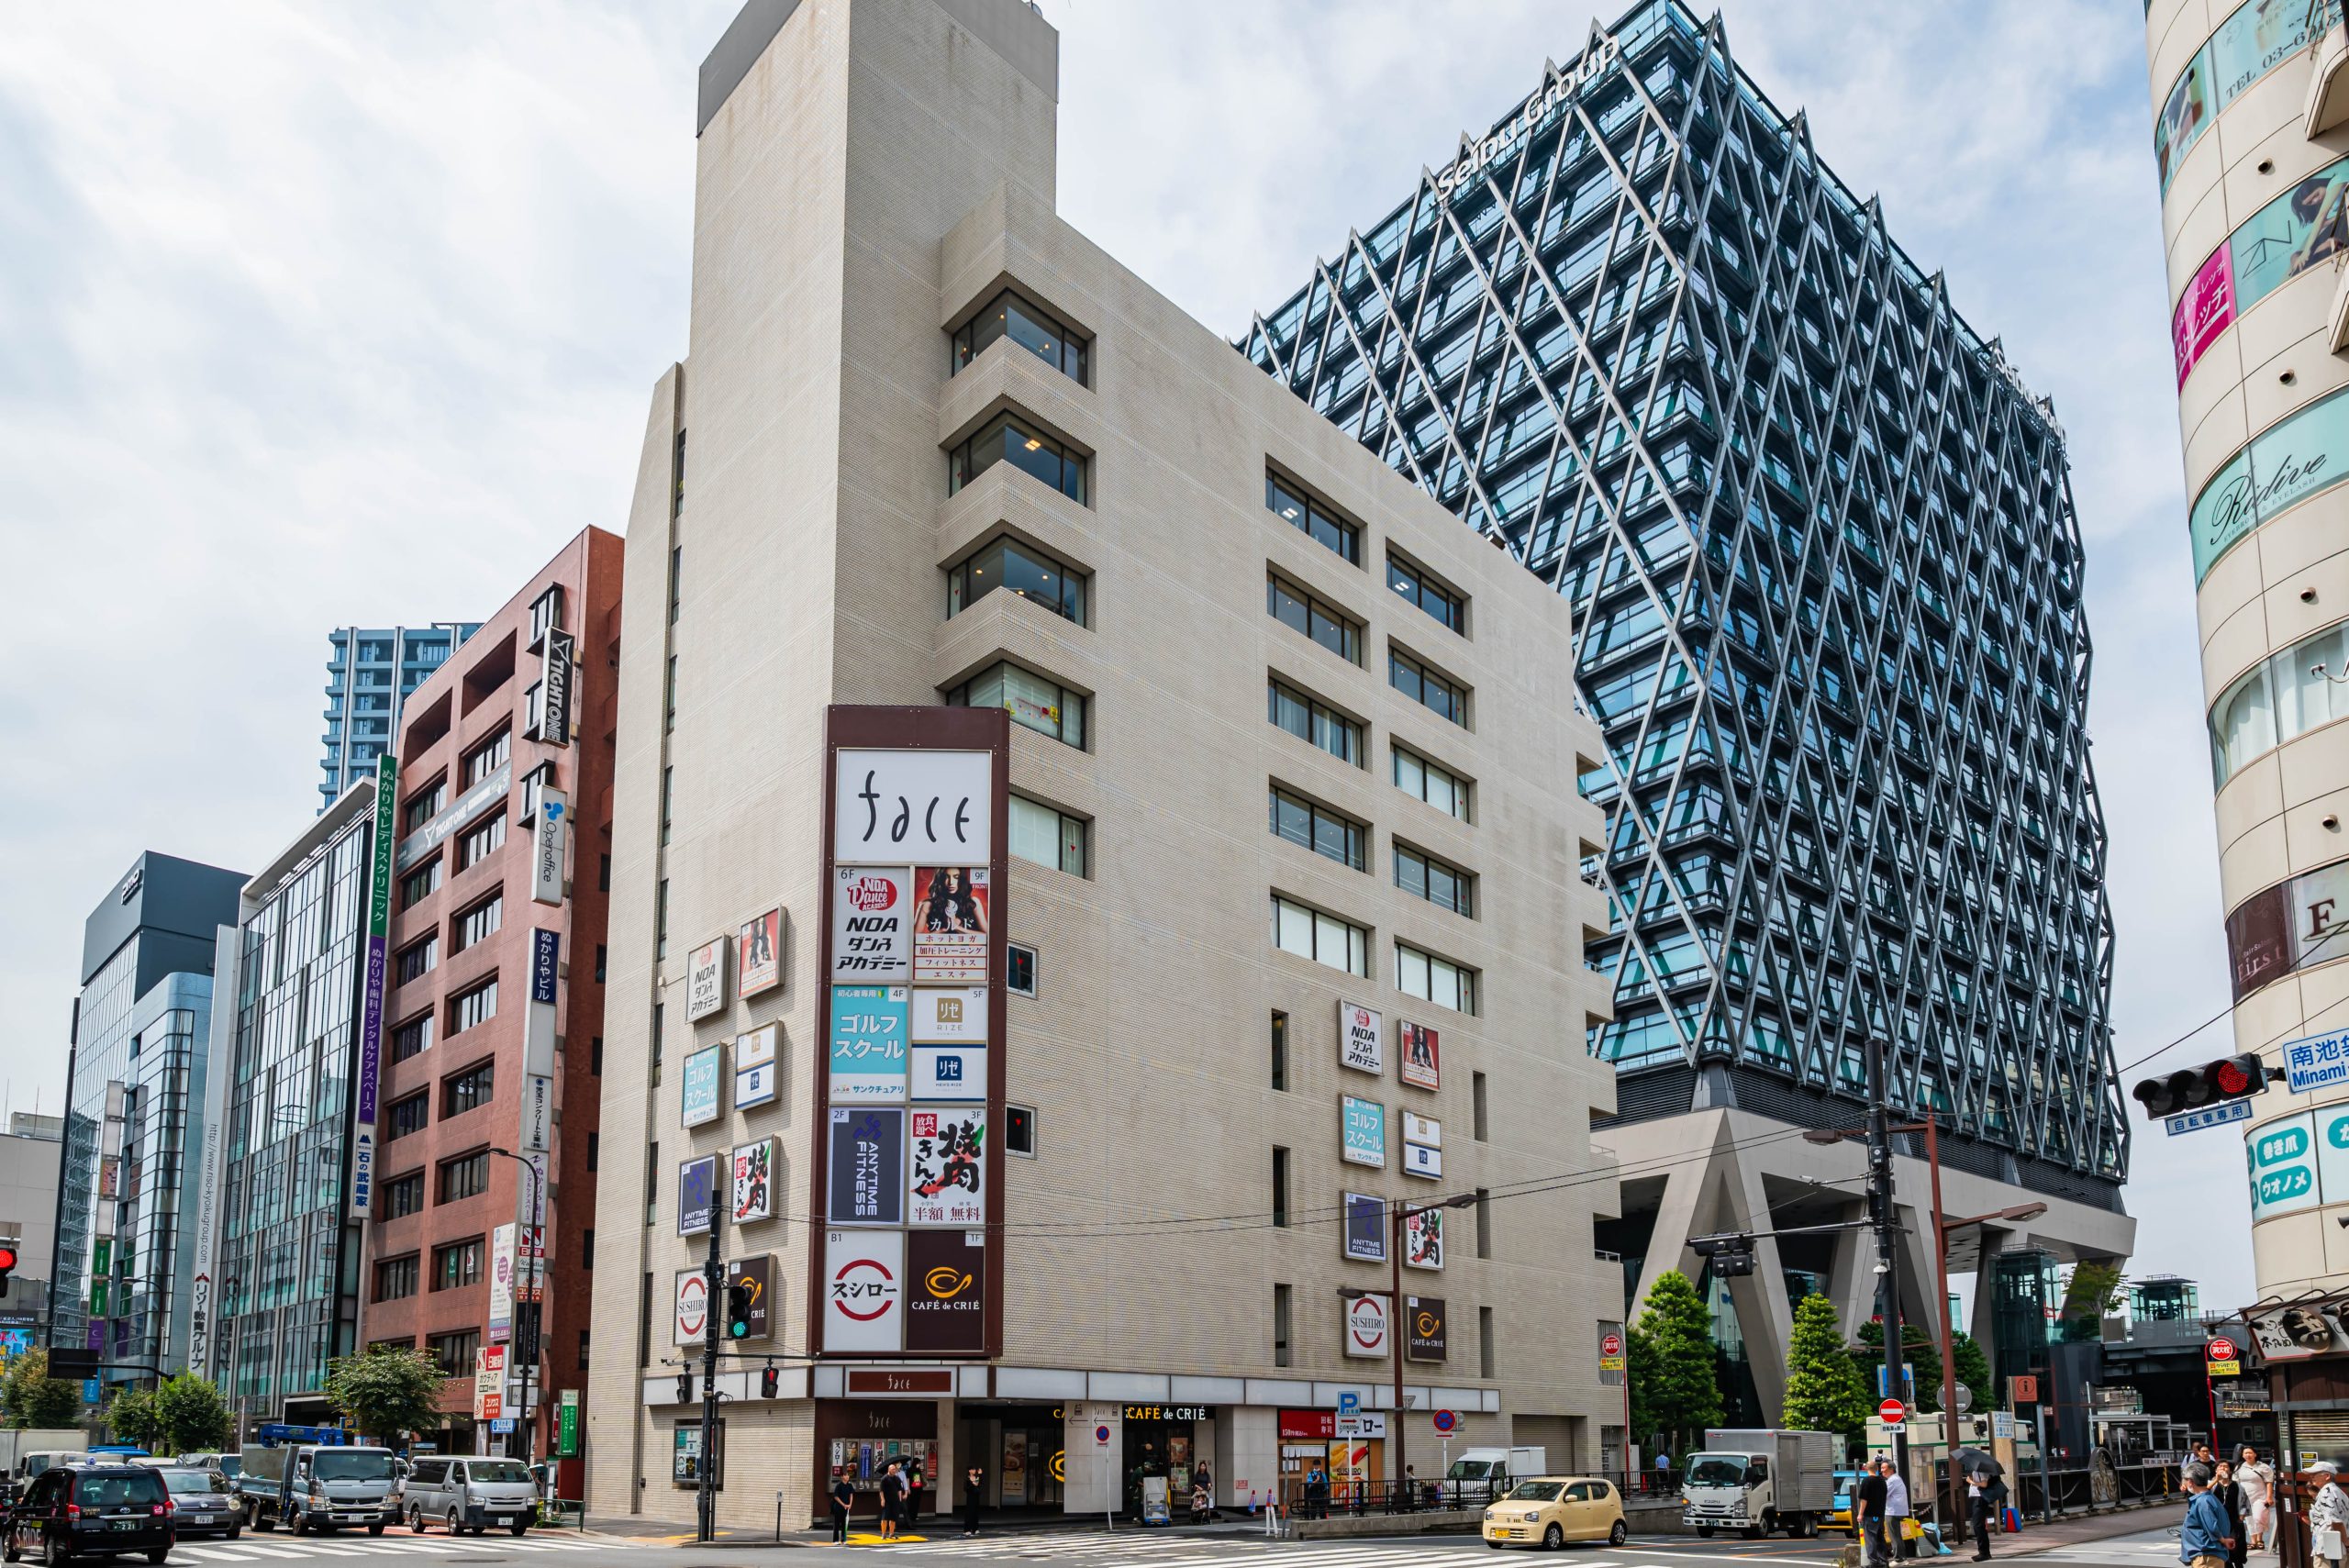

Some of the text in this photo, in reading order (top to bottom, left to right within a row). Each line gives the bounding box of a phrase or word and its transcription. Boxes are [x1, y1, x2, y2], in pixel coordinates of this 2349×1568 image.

[2226, 70, 2256, 99] TEL
[1437, 35, 1620, 202] Seibu Group
[2272, 476, 2316, 506] EYELASH
[858, 770, 970, 843] face
[373, 769, 394, 922] ぬかりやレディスクリニック
[841, 869, 855, 880] 6F
[974, 873, 985, 881] 9F
[846, 917, 898, 932] NOA
[930, 917, 974, 932] カルド
[848, 936, 892, 951] ダンス
[925, 934, 977, 943] ホットヨガ
[918, 947, 983, 956] 加圧トレーニング
[538, 931, 552, 1000] ぬかりやビル
[836, 955, 907, 970] アカデミー
[925, 959, 977, 967] フィットネス
[695, 963, 716, 985] NOA
[695, 980, 713, 999] ダンス
[892, 989, 904, 998] 4F
[973, 990, 984, 998] 5F
[690, 995, 718, 1015] アカデミー
[941, 1002, 959, 1019] リゼ
[840, 1013, 899, 1035] ゴルフ
[1351, 1025, 1375, 1043] NOA
[833, 1038, 905, 1060] スクール
[1353, 1039, 1374, 1054] ダンス
[940, 1060, 959, 1077] リゼ
[1347, 1051, 1380, 1069] アカデミー
[688, 1062, 714, 1086] ゴルフ
[685, 1084, 716, 1107] スクール
[852, 1085, 905, 1094] サンクチュアリ
[833, 1110, 845, 1118] 2F
[1349, 1111, 1378, 1131] ゴルフ
[2174, 1105, 2243, 1131] 自転車専用
[1347, 1129, 1383, 1151] スクール
[937, 1118, 982, 1194] 焼肉
[914, 1139, 935, 1199] きんぐ
[746, 1143, 768, 1213] 焼肉
[855, 1141, 867, 1217] FITNESS
[867, 1141, 879, 1217] ANYTIME
[2262, 1171, 2307, 1199] ウオノメ
[684, 1217, 709, 1228] FITNESS
[685, 1208, 709, 1220] ANYTIME
[913, 1207, 981, 1221] 半額 無料
[830, 1233, 842, 1242] B1
[1352, 1239, 1381, 1249] ANYTIME
[521, 1247, 542, 1257] 日研
[1352, 1245, 1381, 1255] FITNESS
[830, 1282, 897, 1299] スシロー
[678, 1296, 707, 1314] SUSHIRO
[912, 1299, 940, 1310] CAFÉ
[953, 1299, 980, 1310] CRIÉ
[191, 1284, 207, 1370] リソー教育グループ
[1351, 1316, 1385, 1330] SUSHIRO
[1411, 1338, 1425, 1347] CAFÉ
[888, 1373, 911, 1390] face
[869, 1411, 890, 1429] face
[1128, 1405, 1206, 1420] CAFÉ de CRIÉ
